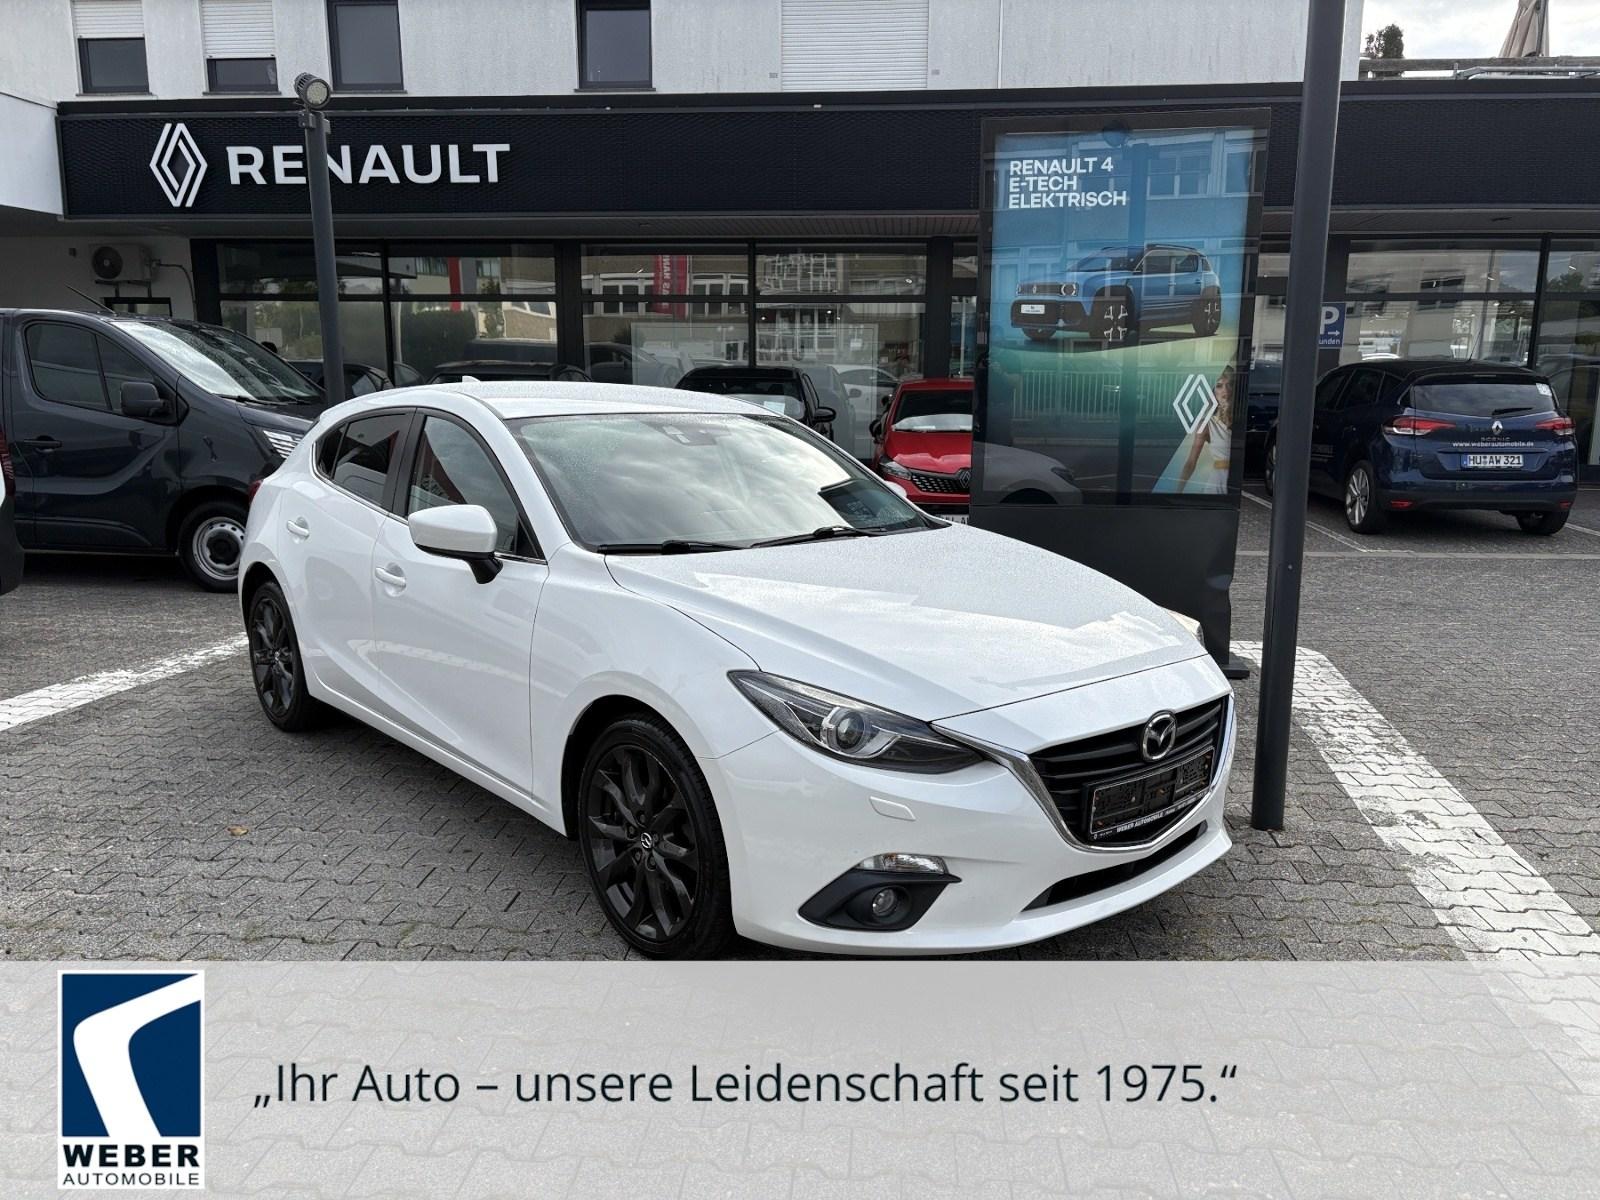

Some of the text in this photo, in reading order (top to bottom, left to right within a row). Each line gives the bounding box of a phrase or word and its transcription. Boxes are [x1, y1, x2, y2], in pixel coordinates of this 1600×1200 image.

[226, 144, 510, 185] RENAULT
[1009, 157, 1114, 175] RENAULT 4
[1009, 176, 1077, 192] E-TECH
[1009, 191, 1127, 208] ELEKTRISCH
[1320, 306, 1340, 335] P
[1452, 440, 1534, 448] www.weberautomobile.de
[1469, 455, 1521, 465] HU AW 321
